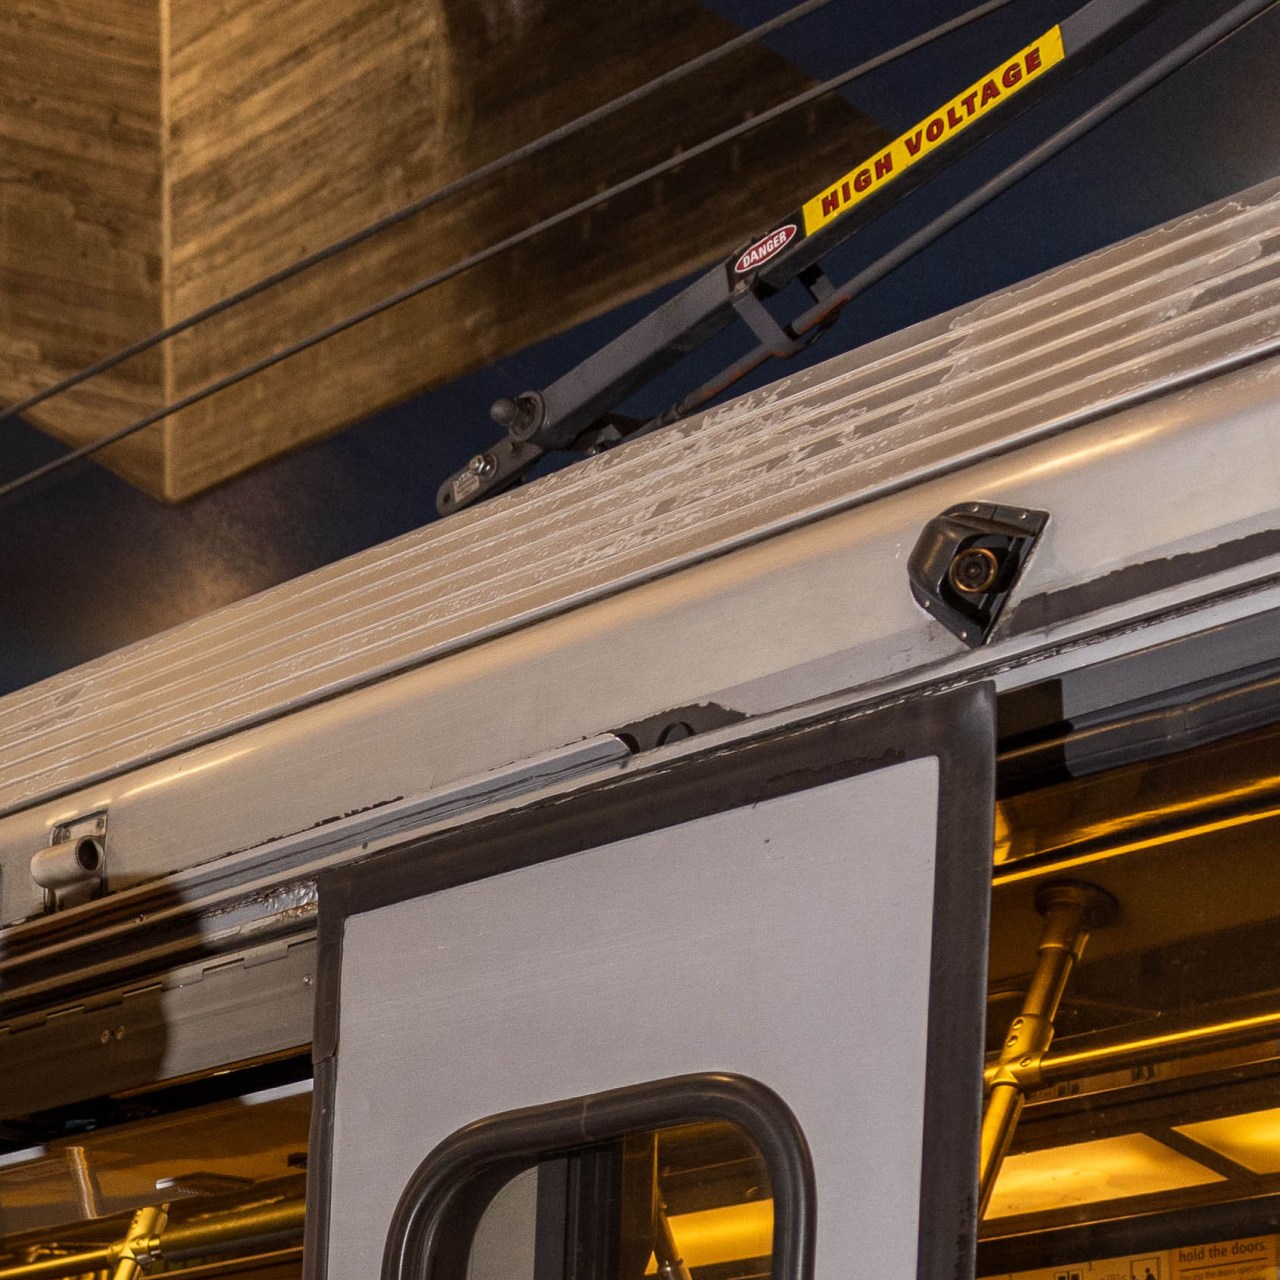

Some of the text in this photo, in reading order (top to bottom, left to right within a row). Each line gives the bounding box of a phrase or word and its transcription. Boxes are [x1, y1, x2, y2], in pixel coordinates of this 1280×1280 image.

[821, 46, 1042, 218] HIGH VOLTAGE
[742, 231, 786, 268] DANGER
[1178, 1246, 1205, 1264] hold
[1208, 1244, 1228, 1260] the
